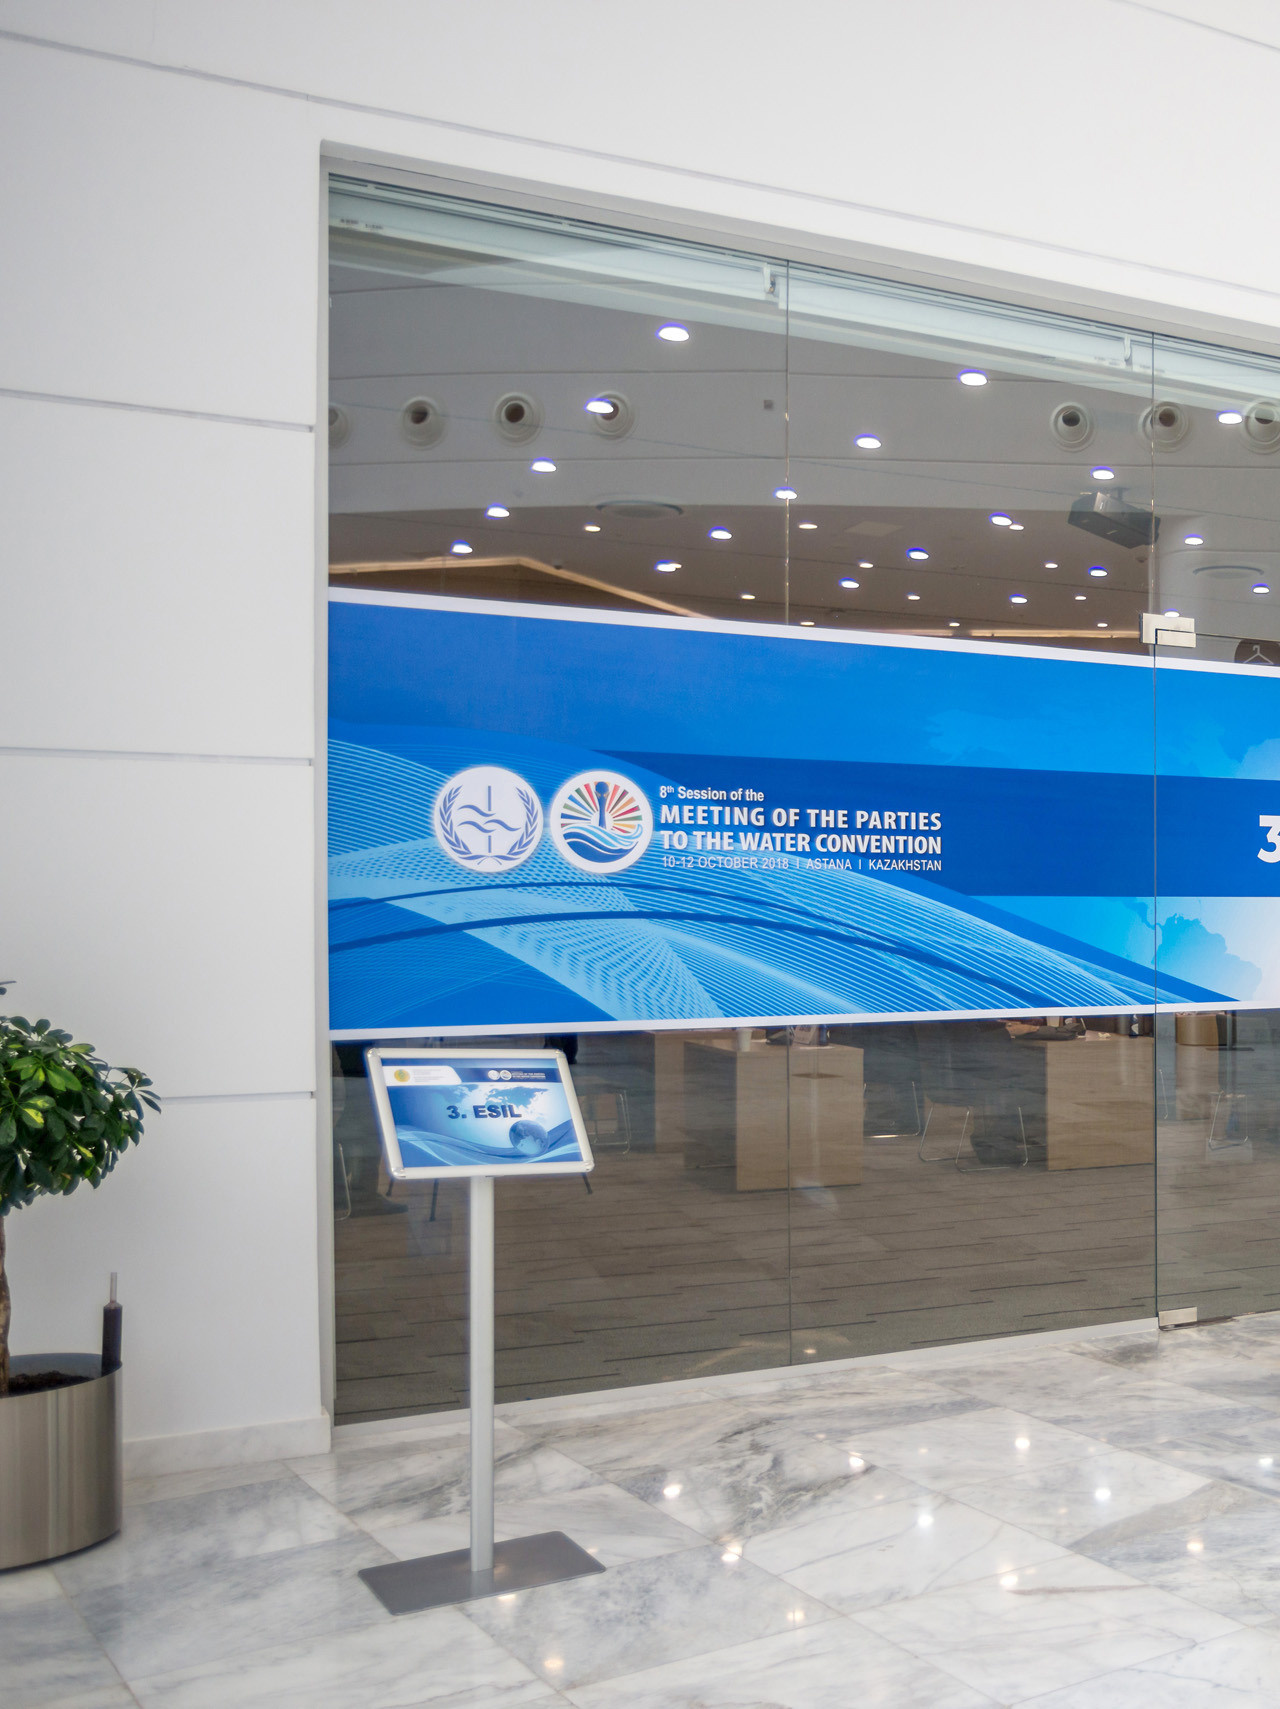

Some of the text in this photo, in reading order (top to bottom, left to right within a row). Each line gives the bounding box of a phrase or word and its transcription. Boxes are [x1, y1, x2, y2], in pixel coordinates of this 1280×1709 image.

[678, 786, 727, 800] Session
[730, 788, 743, 801] of
[745, 788, 765, 802] the
[660, 804, 942, 831] MEETING OF THE PARTIES
[660, 830, 942, 855] TO THE WATER CONVENTION
[662, 855, 942, 872] 10-12 OCTOBER 2018 ASTANA KAZAKHSTAN
[446, 1104, 523, 1120] 3. ESIL
